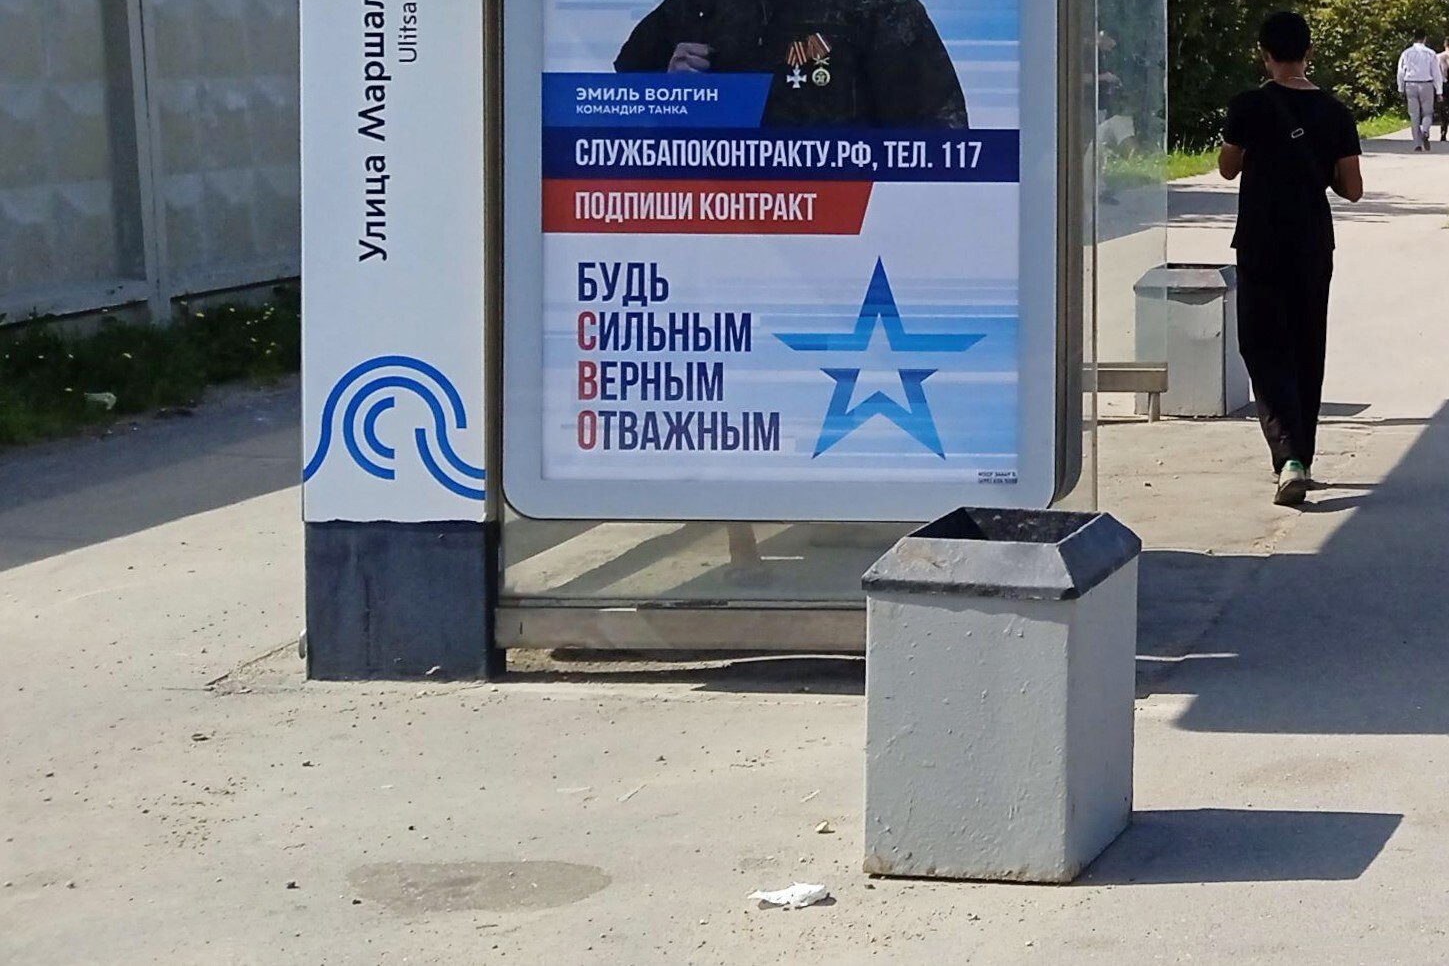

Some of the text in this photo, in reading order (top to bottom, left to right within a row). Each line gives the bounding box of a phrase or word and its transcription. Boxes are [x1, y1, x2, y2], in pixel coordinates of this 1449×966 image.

[397, 2, 418, 63] Ulitsa
[575, 87, 719, 101] ЭМИЛЬ ВОЛГИН
[575, 104, 688, 115] КОМАНДИР ТАНКА
[575, 139, 982, 171] СЛУЖБАПОКОНТРАКТУ.РФ, ТЕЛ. 117
[358, 154, 390, 262] Улица
[574, 192, 817, 222] ПОДПИШИ КОНТРАКТ
[577, 262, 669, 307] БУДЬ
[577, 311, 752, 352] СИЛЬНЫМ
[577, 361, 723, 401] ВЕРНЫМ
[577, 410, 780, 451] ОТВАЖНЫМ
